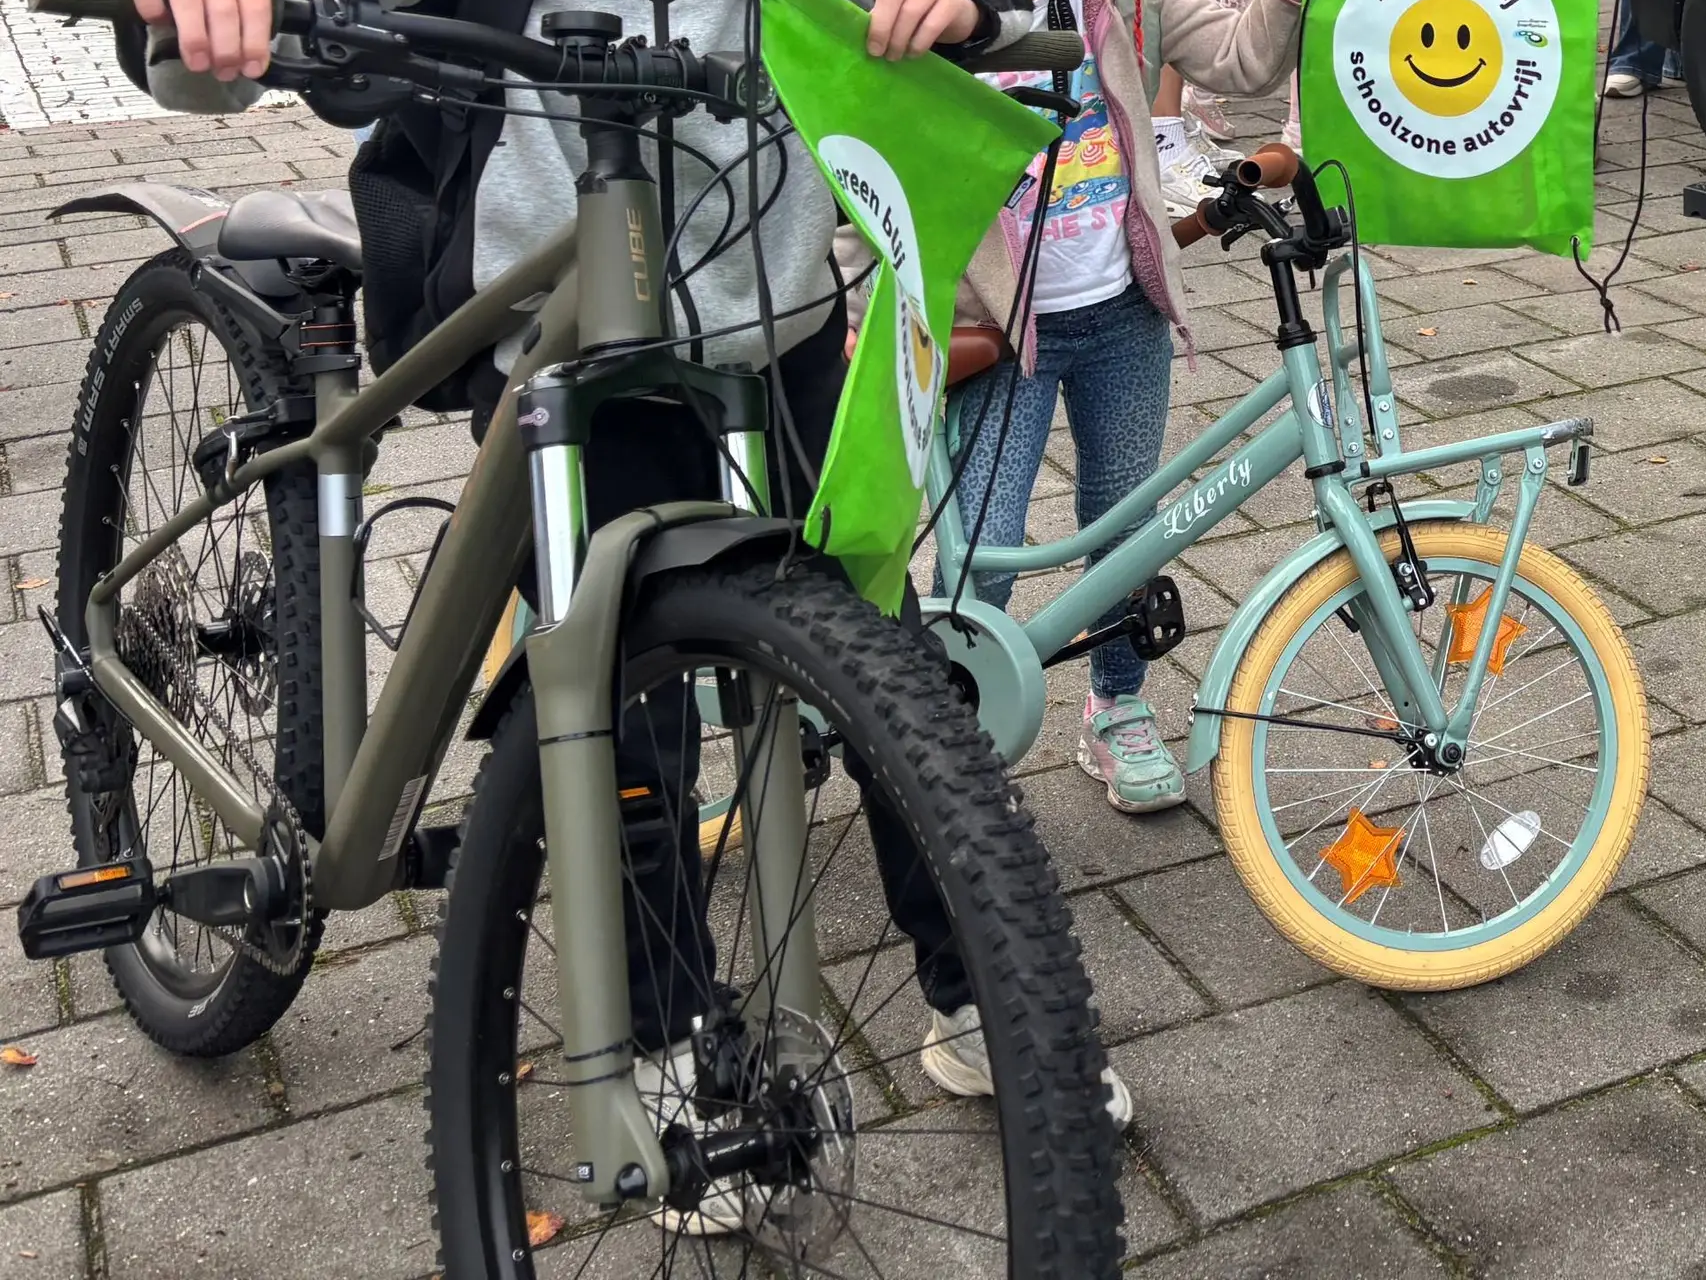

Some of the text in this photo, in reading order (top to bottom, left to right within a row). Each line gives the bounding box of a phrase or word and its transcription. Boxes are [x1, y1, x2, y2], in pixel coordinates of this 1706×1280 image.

[1350, 51, 1542, 155] schoolzone autovrij!
[626, 207, 651, 301] CUBE
[81, 297, 145, 432] SMART SAM
[1163, 458, 1253, 539] Liberty
